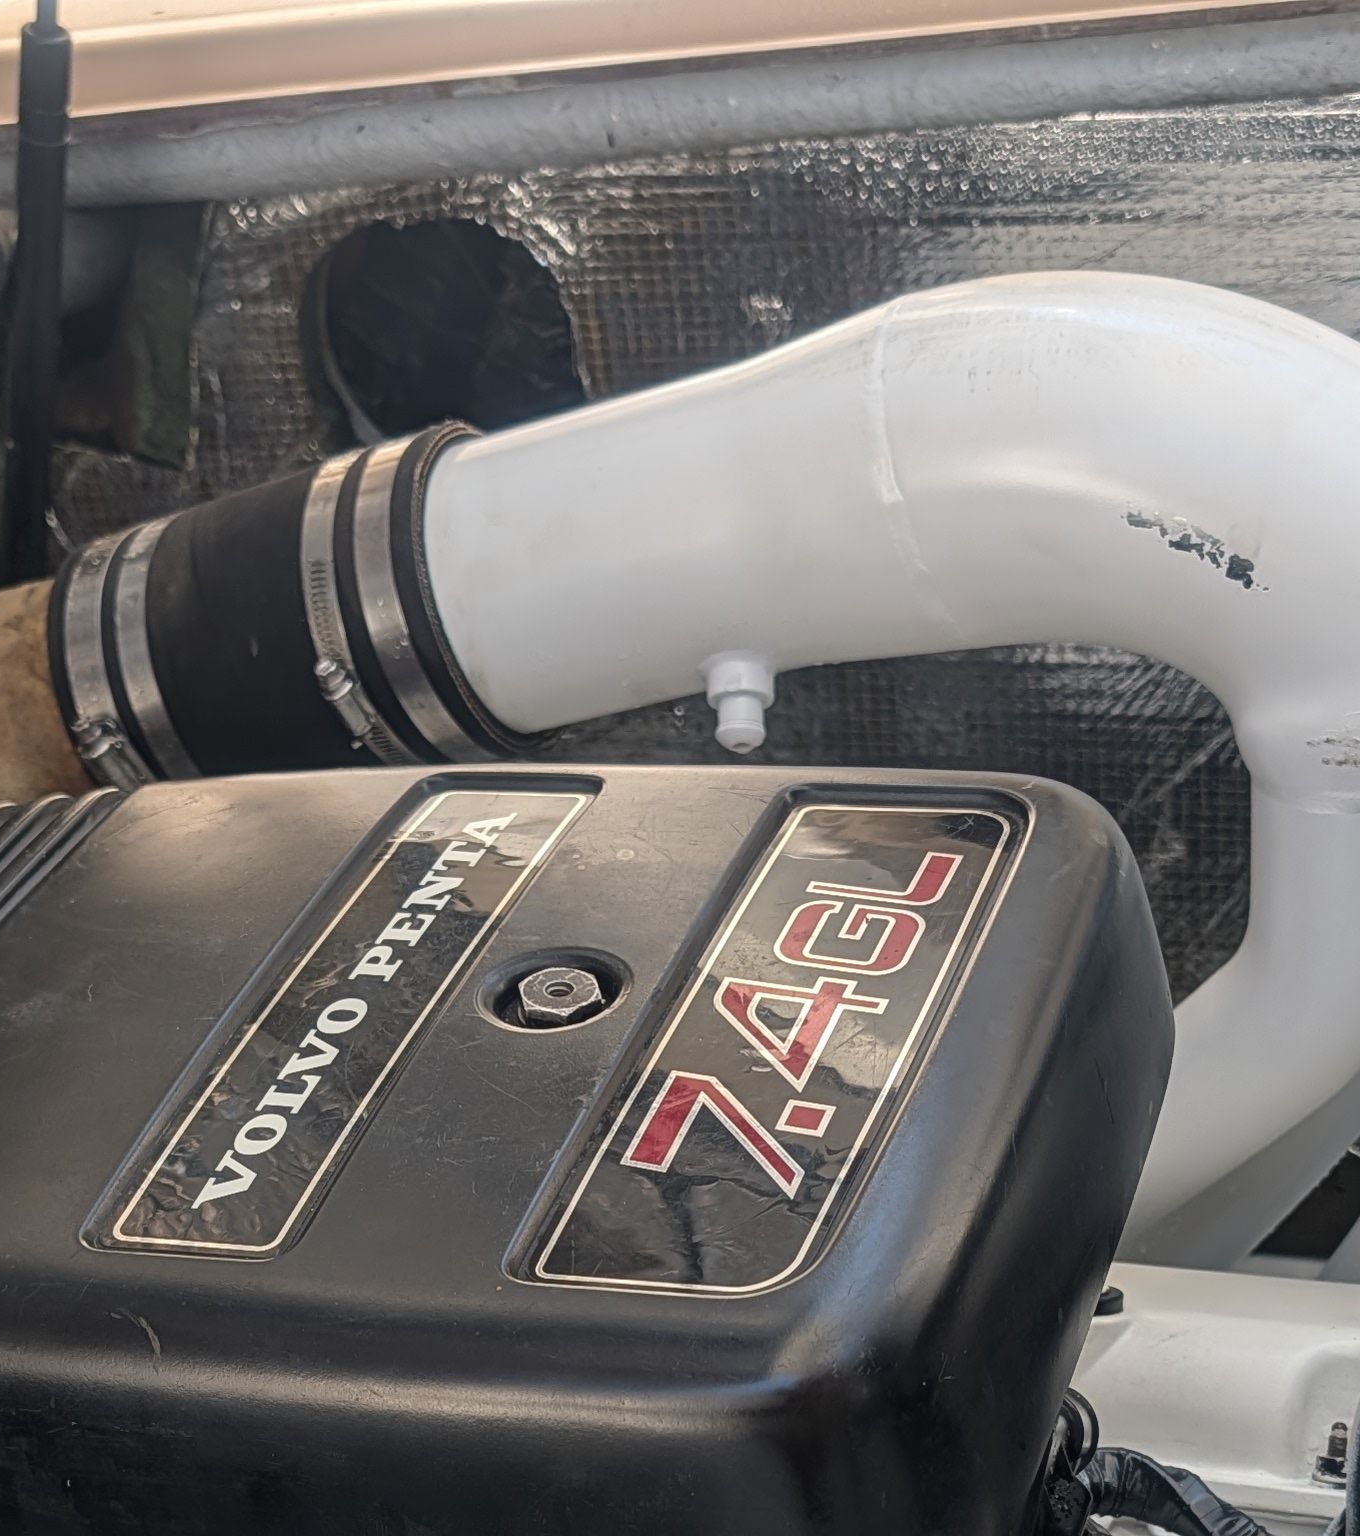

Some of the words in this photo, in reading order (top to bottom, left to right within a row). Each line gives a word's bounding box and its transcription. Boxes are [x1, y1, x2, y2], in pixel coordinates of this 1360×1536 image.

[192, 996, 370, 1211] VOLVO
[349, 810, 518, 986] PENTA
[620, 852, 965, 1200] 7.4GL
